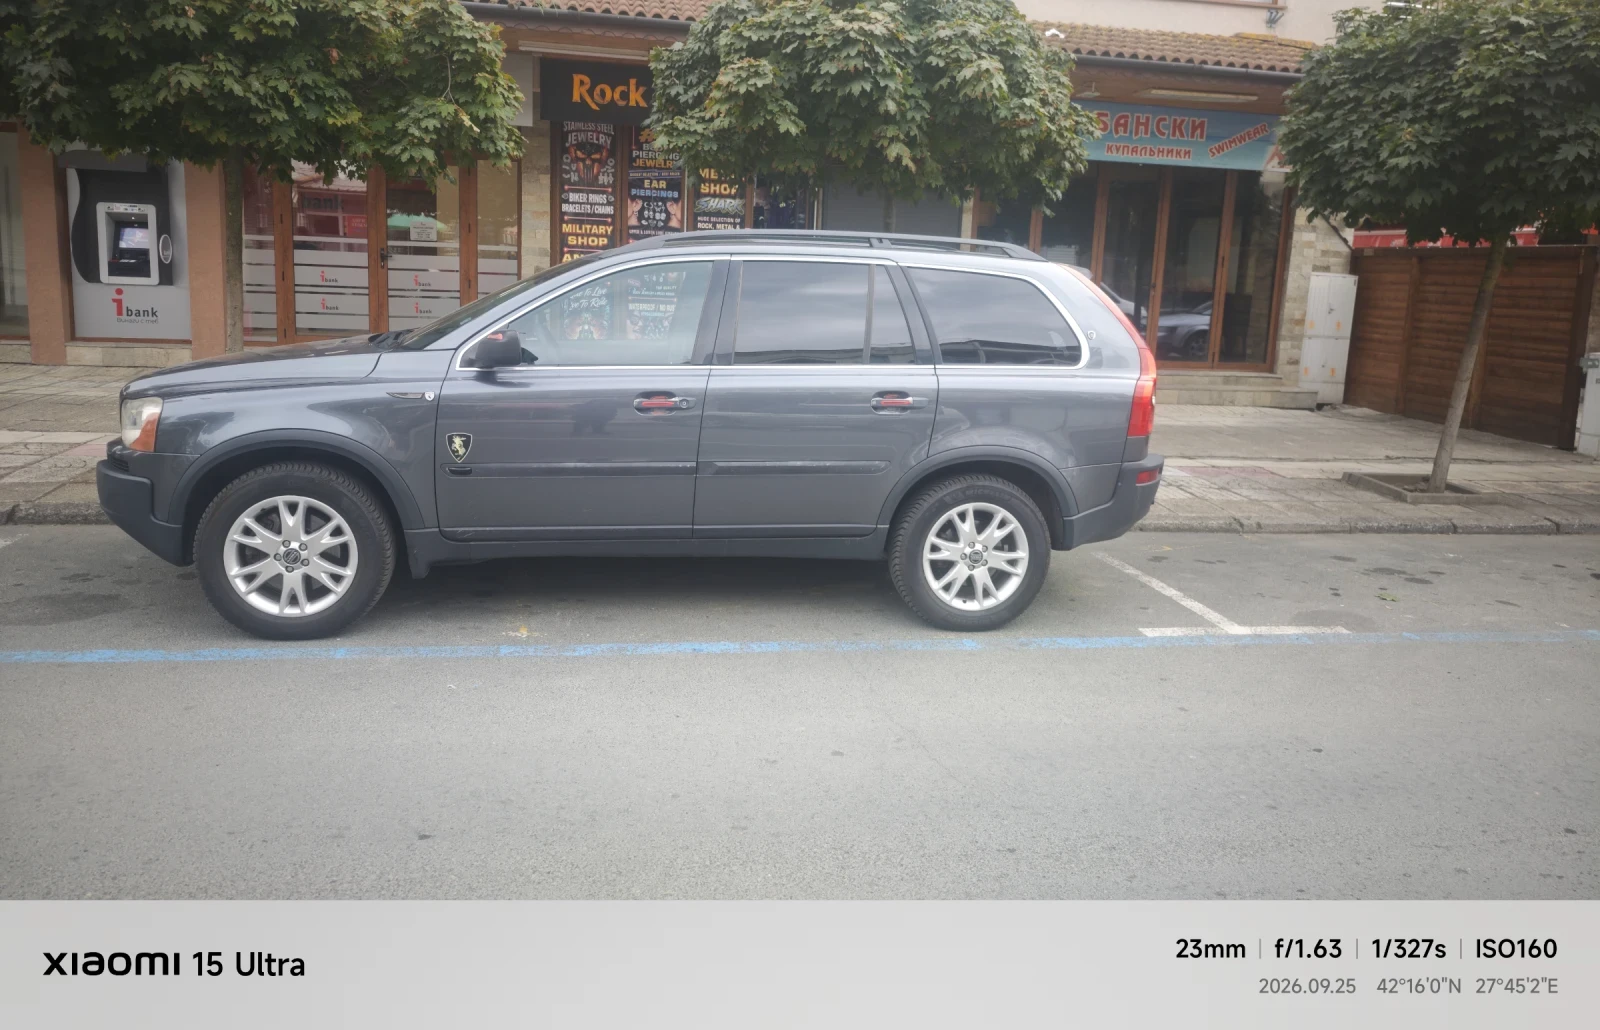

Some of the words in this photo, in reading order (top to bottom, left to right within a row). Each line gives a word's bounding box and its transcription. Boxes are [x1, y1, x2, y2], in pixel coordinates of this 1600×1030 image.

[571, 73, 648, 110] Rock
[563, 121, 596, 131] STAINLESS
[597, 123, 615, 135] STEEL
[1096, 111, 1207, 141] БАНСКИ
[565, 132, 612, 148] JEWELRY
[1208, 122, 1269, 159] SWIMWEAR
[1105, 142, 1192, 160] КУПАЛЬНИКИ
[632, 158, 676, 168] JEWELR
[644, 180, 667, 189] EAR
[569, 192, 588, 203] BIKER
[588, 193, 608, 204] RINGS
[631, 189, 679, 198] PIERCINGS
[562, 204, 591, 213] BRACELETS
[595, 205, 614, 214] CHAINS
[694, 197, 745, 215] SHARK
[562, 223, 613, 235] MILITARY
[568, 236, 608, 247] SHOP
